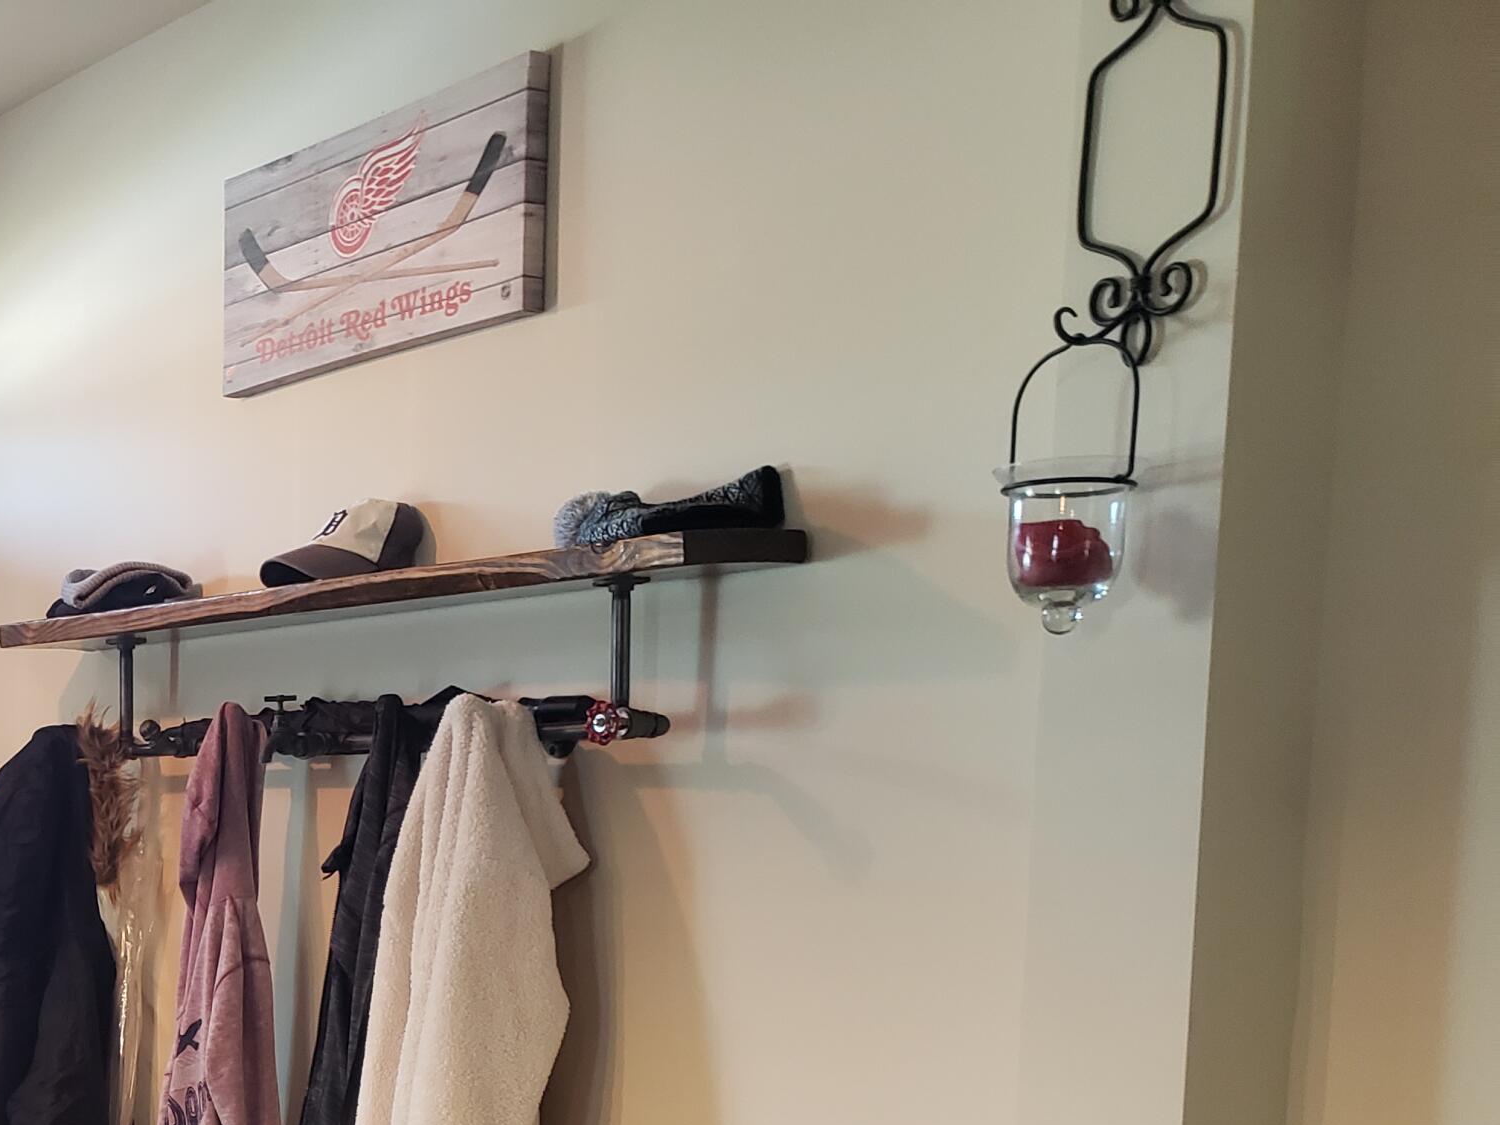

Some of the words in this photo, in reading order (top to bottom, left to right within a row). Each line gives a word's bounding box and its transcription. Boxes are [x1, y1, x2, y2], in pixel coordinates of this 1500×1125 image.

[256, 317, 336, 364] Detroit
[340, 299, 387, 341] Red
[390, 280, 473, 321] Wings
